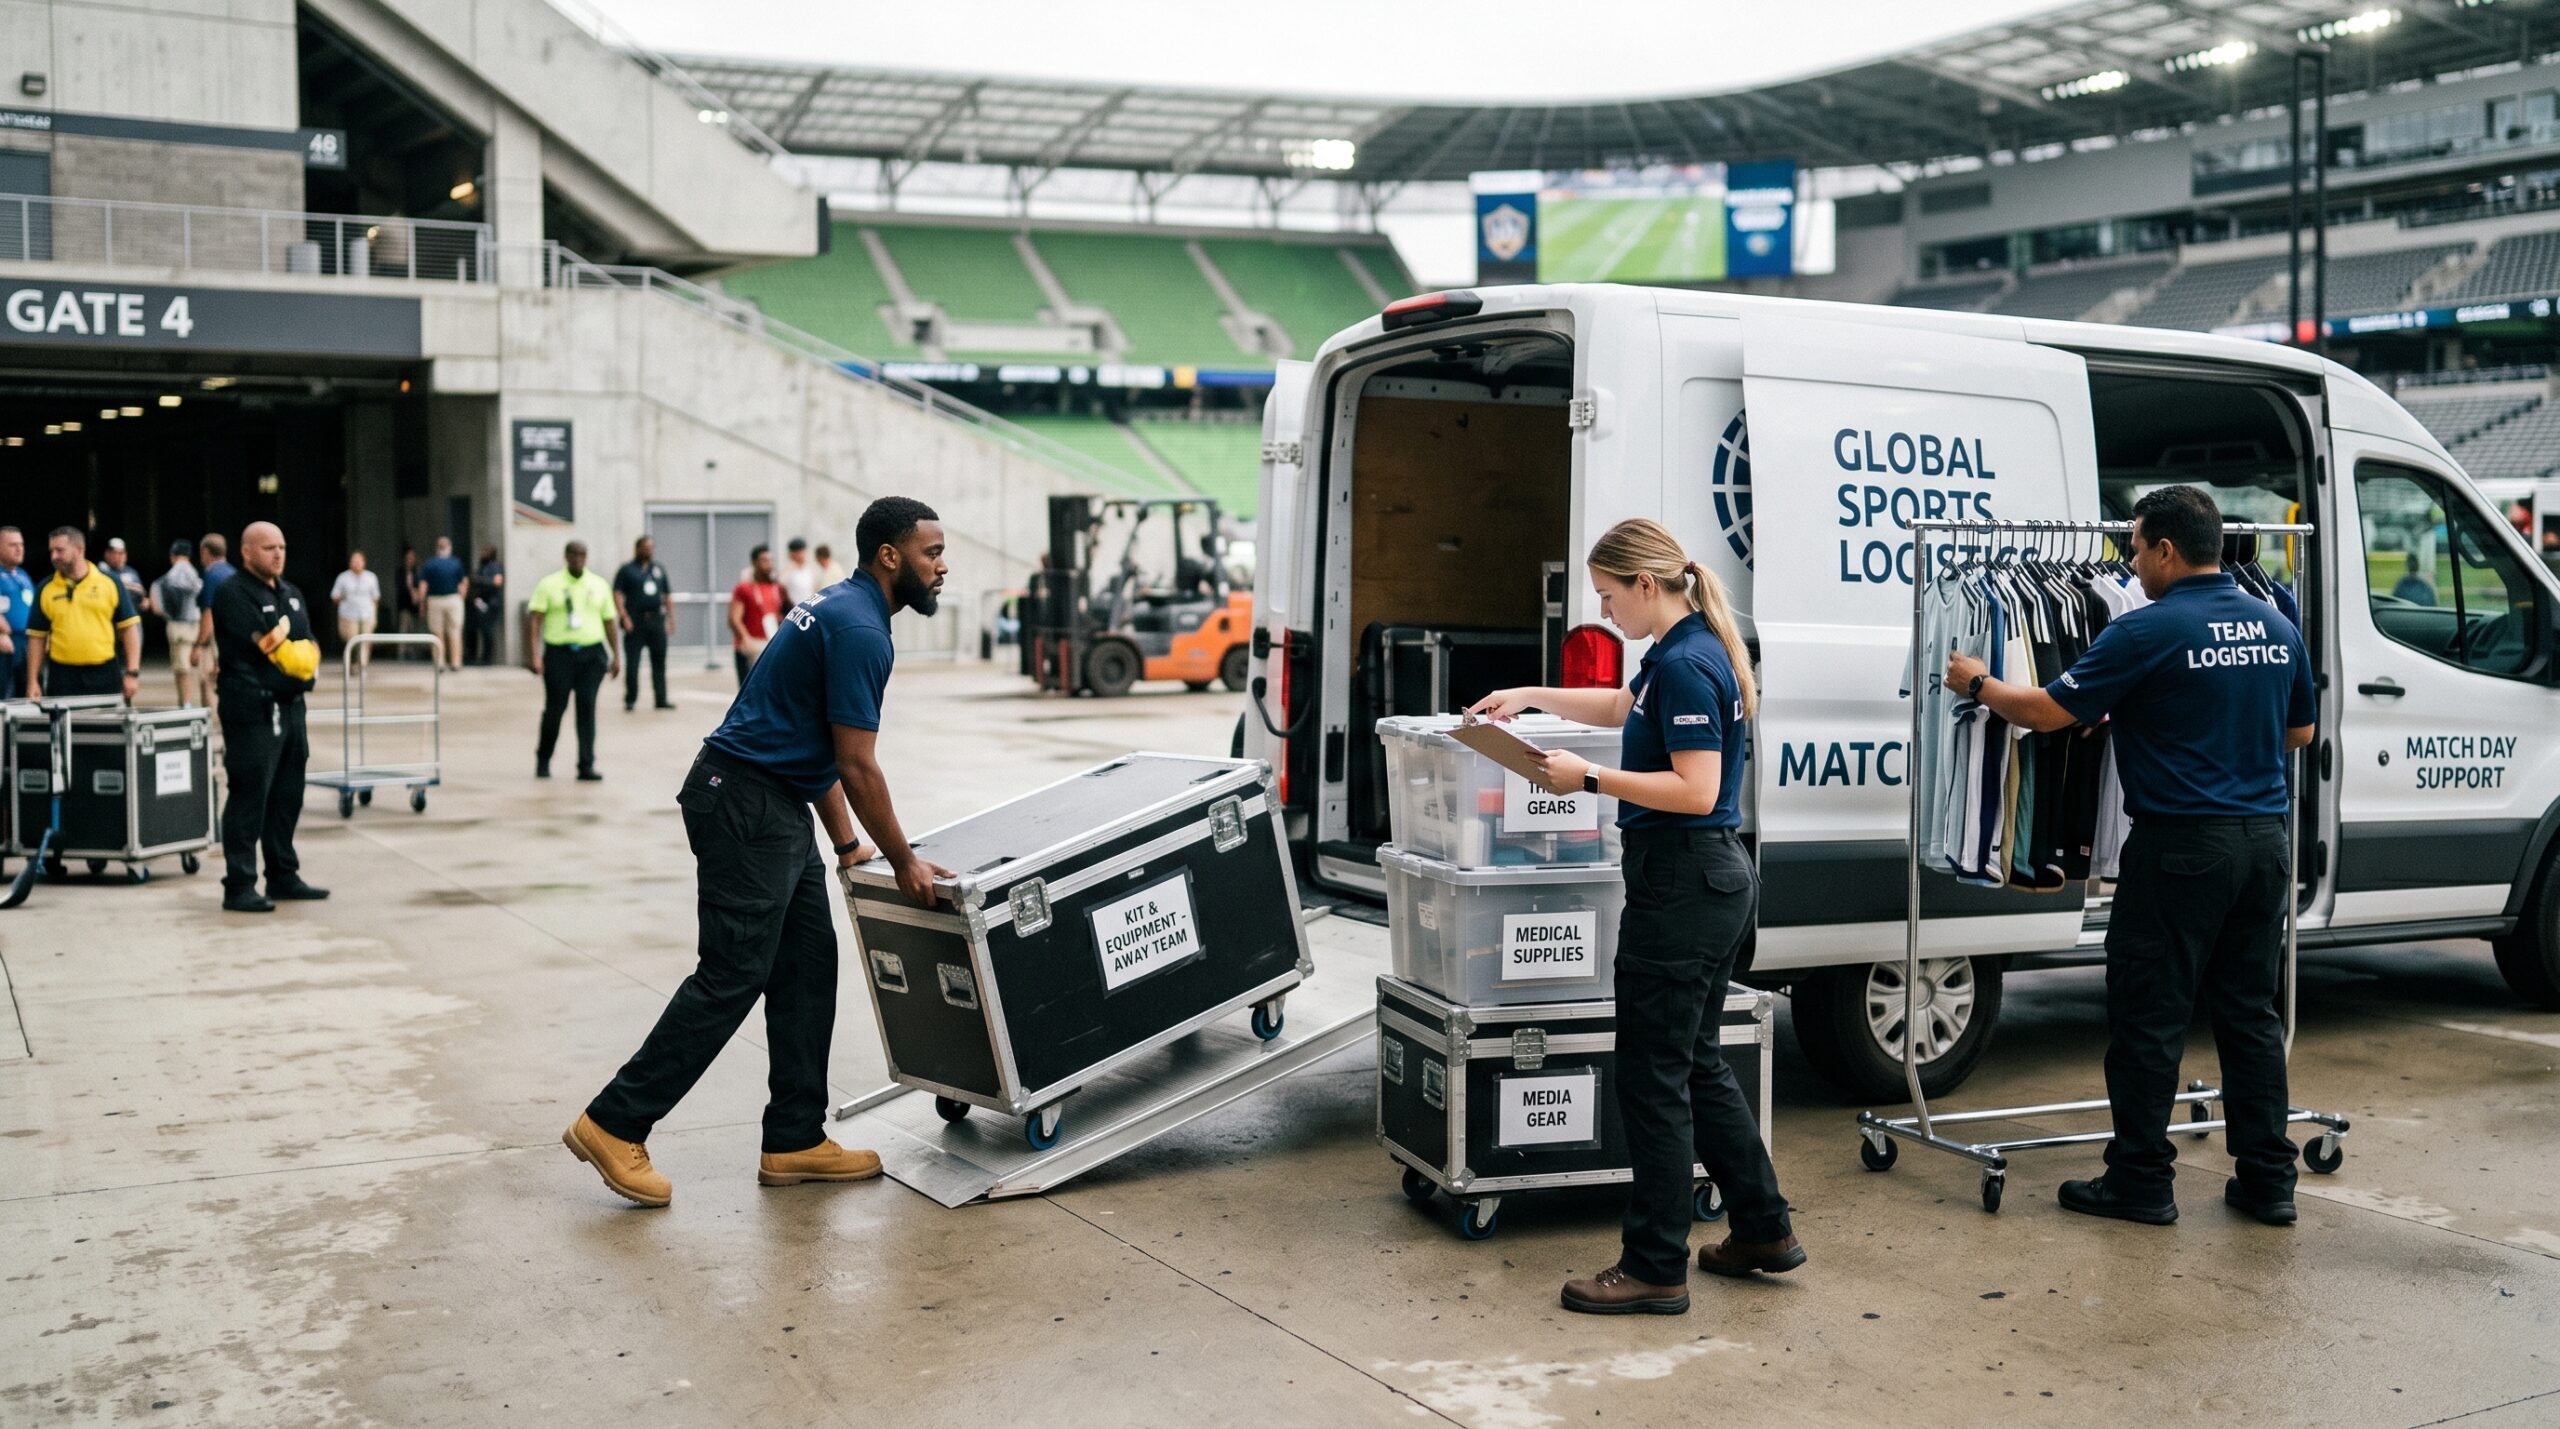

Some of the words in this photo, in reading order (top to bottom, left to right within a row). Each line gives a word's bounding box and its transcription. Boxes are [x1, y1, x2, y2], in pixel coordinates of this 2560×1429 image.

[6, 288, 146, 337] GATE
[160, 295, 194, 338] 4
[1834, 428, 1995, 479] GLOBAL
[530, 473, 557, 507] 4
[1837, 483, 1994, 534] SPORTS
[2207, 620, 2267, 642] TEAM
[2187, 645, 2290, 669] LOGISTICS
[2406, 736, 2474, 759] MATCH
[2480, 736, 2517, 759] DAY
[1778, 741, 1911, 787] MATC
[2416, 766, 2505, 789] SUPPORT
[1527, 800, 1576, 815] GEARS
[1125, 904, 1144, 925] KIT
[1148, 901, 1159, 916] &
[1105, 911, 1177, 955] EQUIPMENT
[1515, 925, 1582, 942] MEDICAL
[1114, 944, 1149, 972] AWAY
[1151, 928, 1188, 955] TEAM
[1513, 946, 1584, 964] SUPPLIES
[1523, 1089, 1572, 1106] MEDIA
[1527, 1111, 1567, 1127] GEAR
